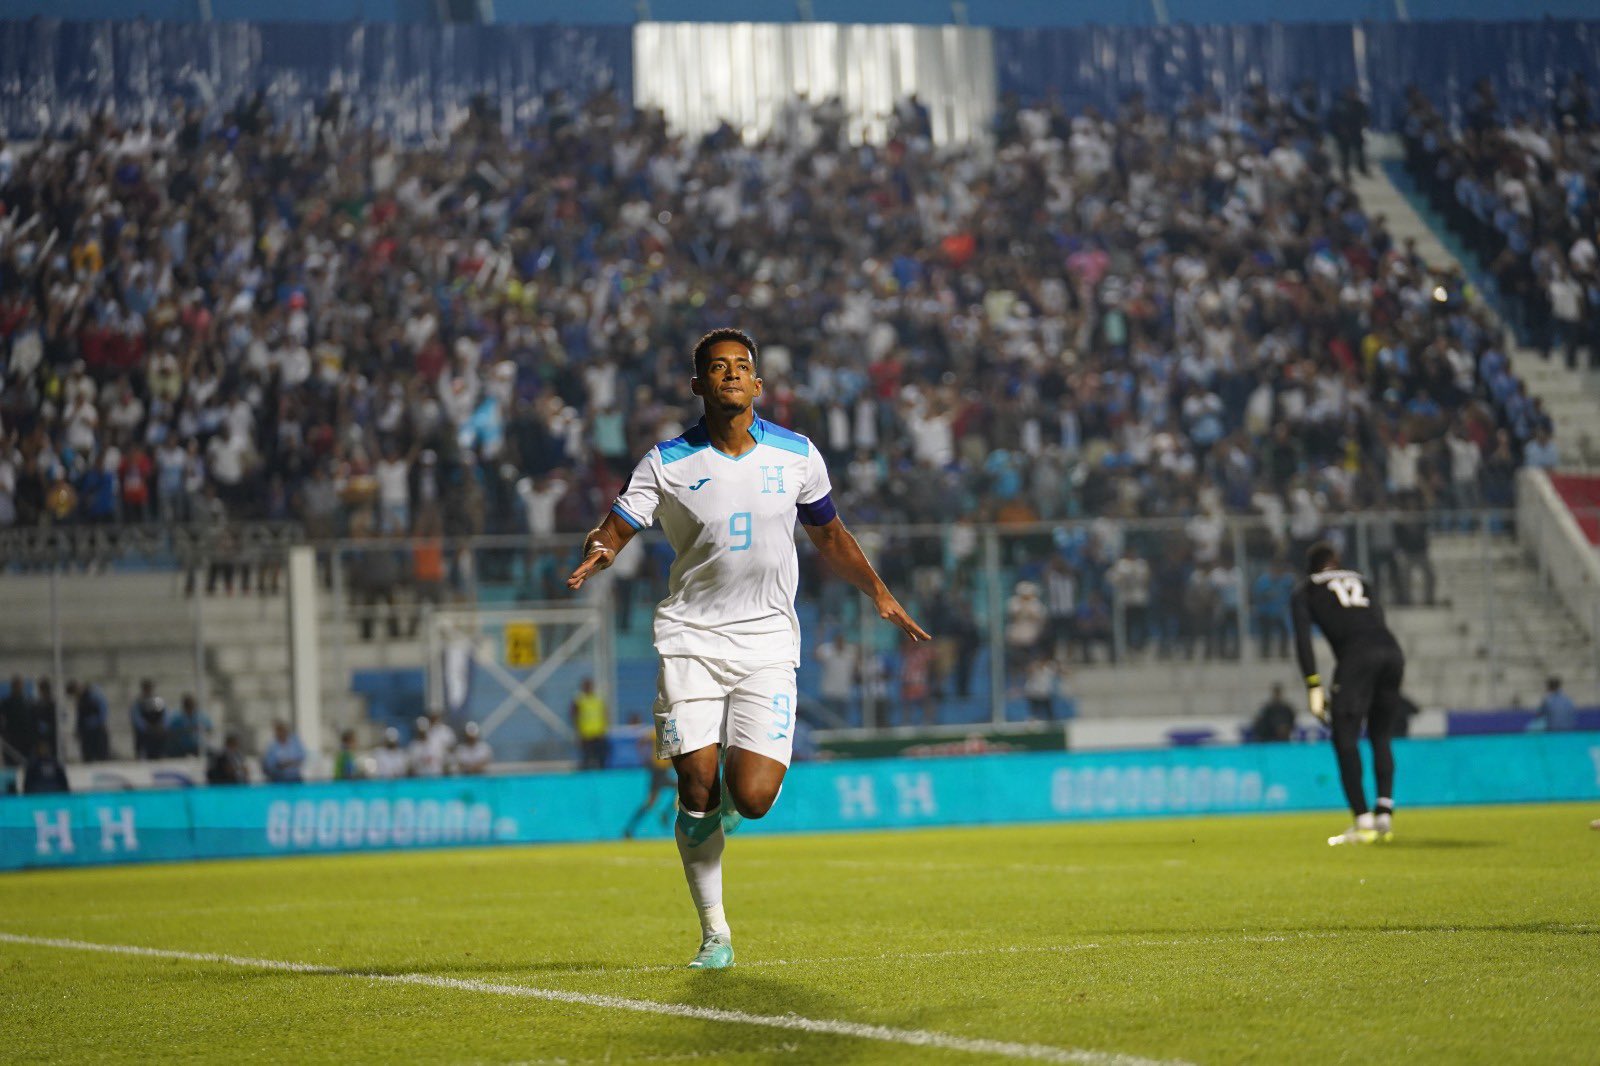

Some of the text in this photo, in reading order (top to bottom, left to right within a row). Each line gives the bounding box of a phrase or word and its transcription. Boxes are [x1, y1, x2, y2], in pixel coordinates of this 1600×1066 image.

[729, 512, 752, 551] 9
[1327, 577, 1370, 607] 12
[33, 806, 139, 855] H H
